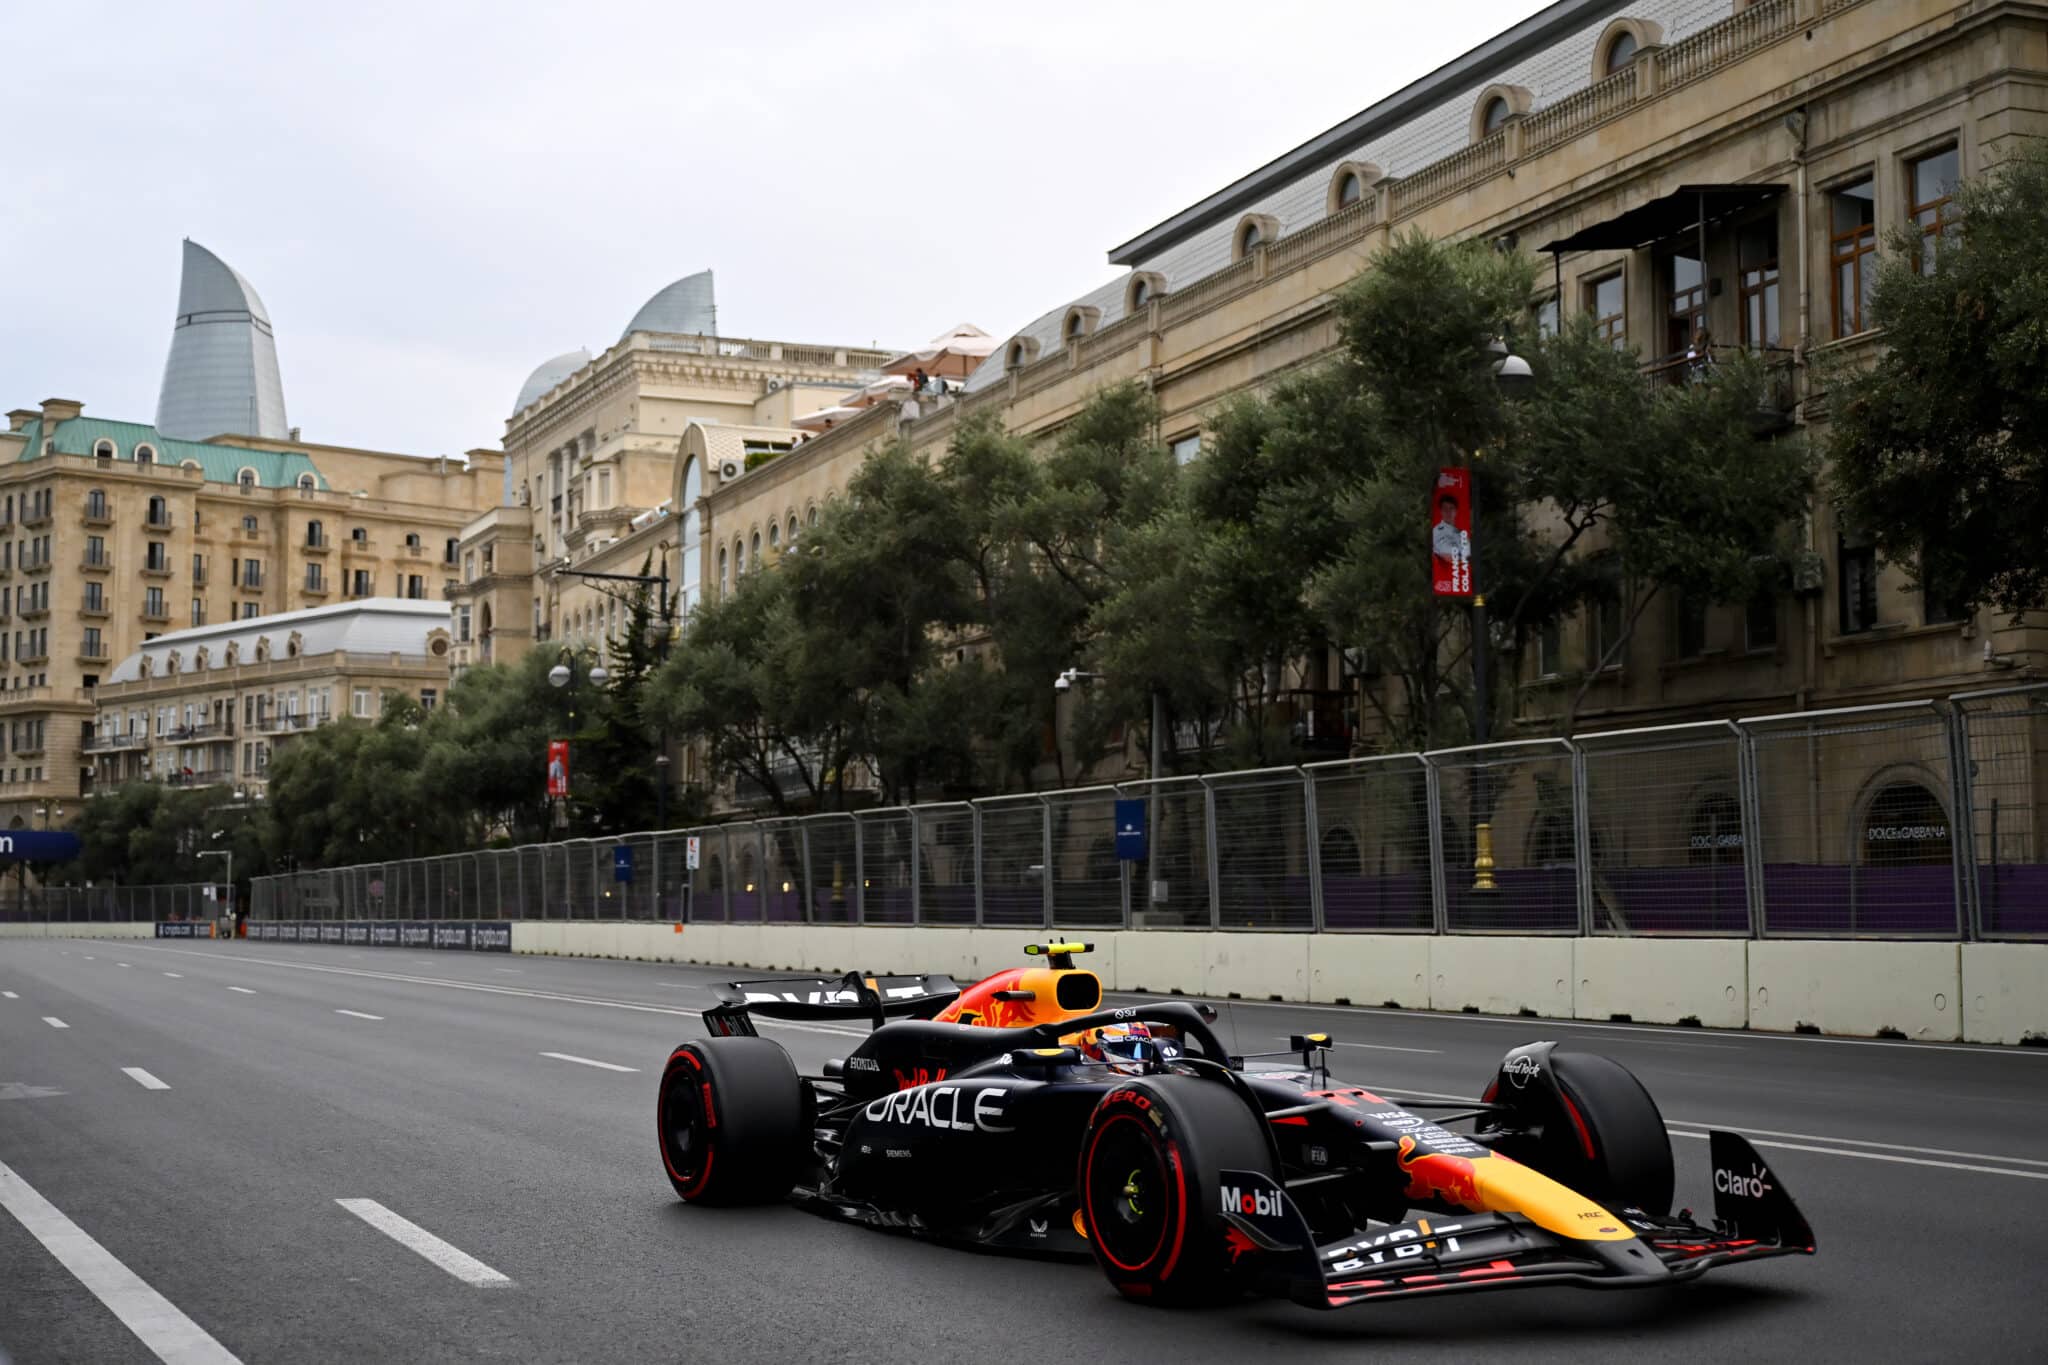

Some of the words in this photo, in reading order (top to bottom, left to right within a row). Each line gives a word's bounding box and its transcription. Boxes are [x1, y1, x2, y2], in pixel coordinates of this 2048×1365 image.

[1452, 547, 1460, 593] FRANCO
[850, 1057, 880, 1072] HONDA
[866, 1087, 1016, 1132] ORACLE
[1715, 1168, 1764, 1198] Claro
[1220, 1186, 1284, 1217] Mobil
